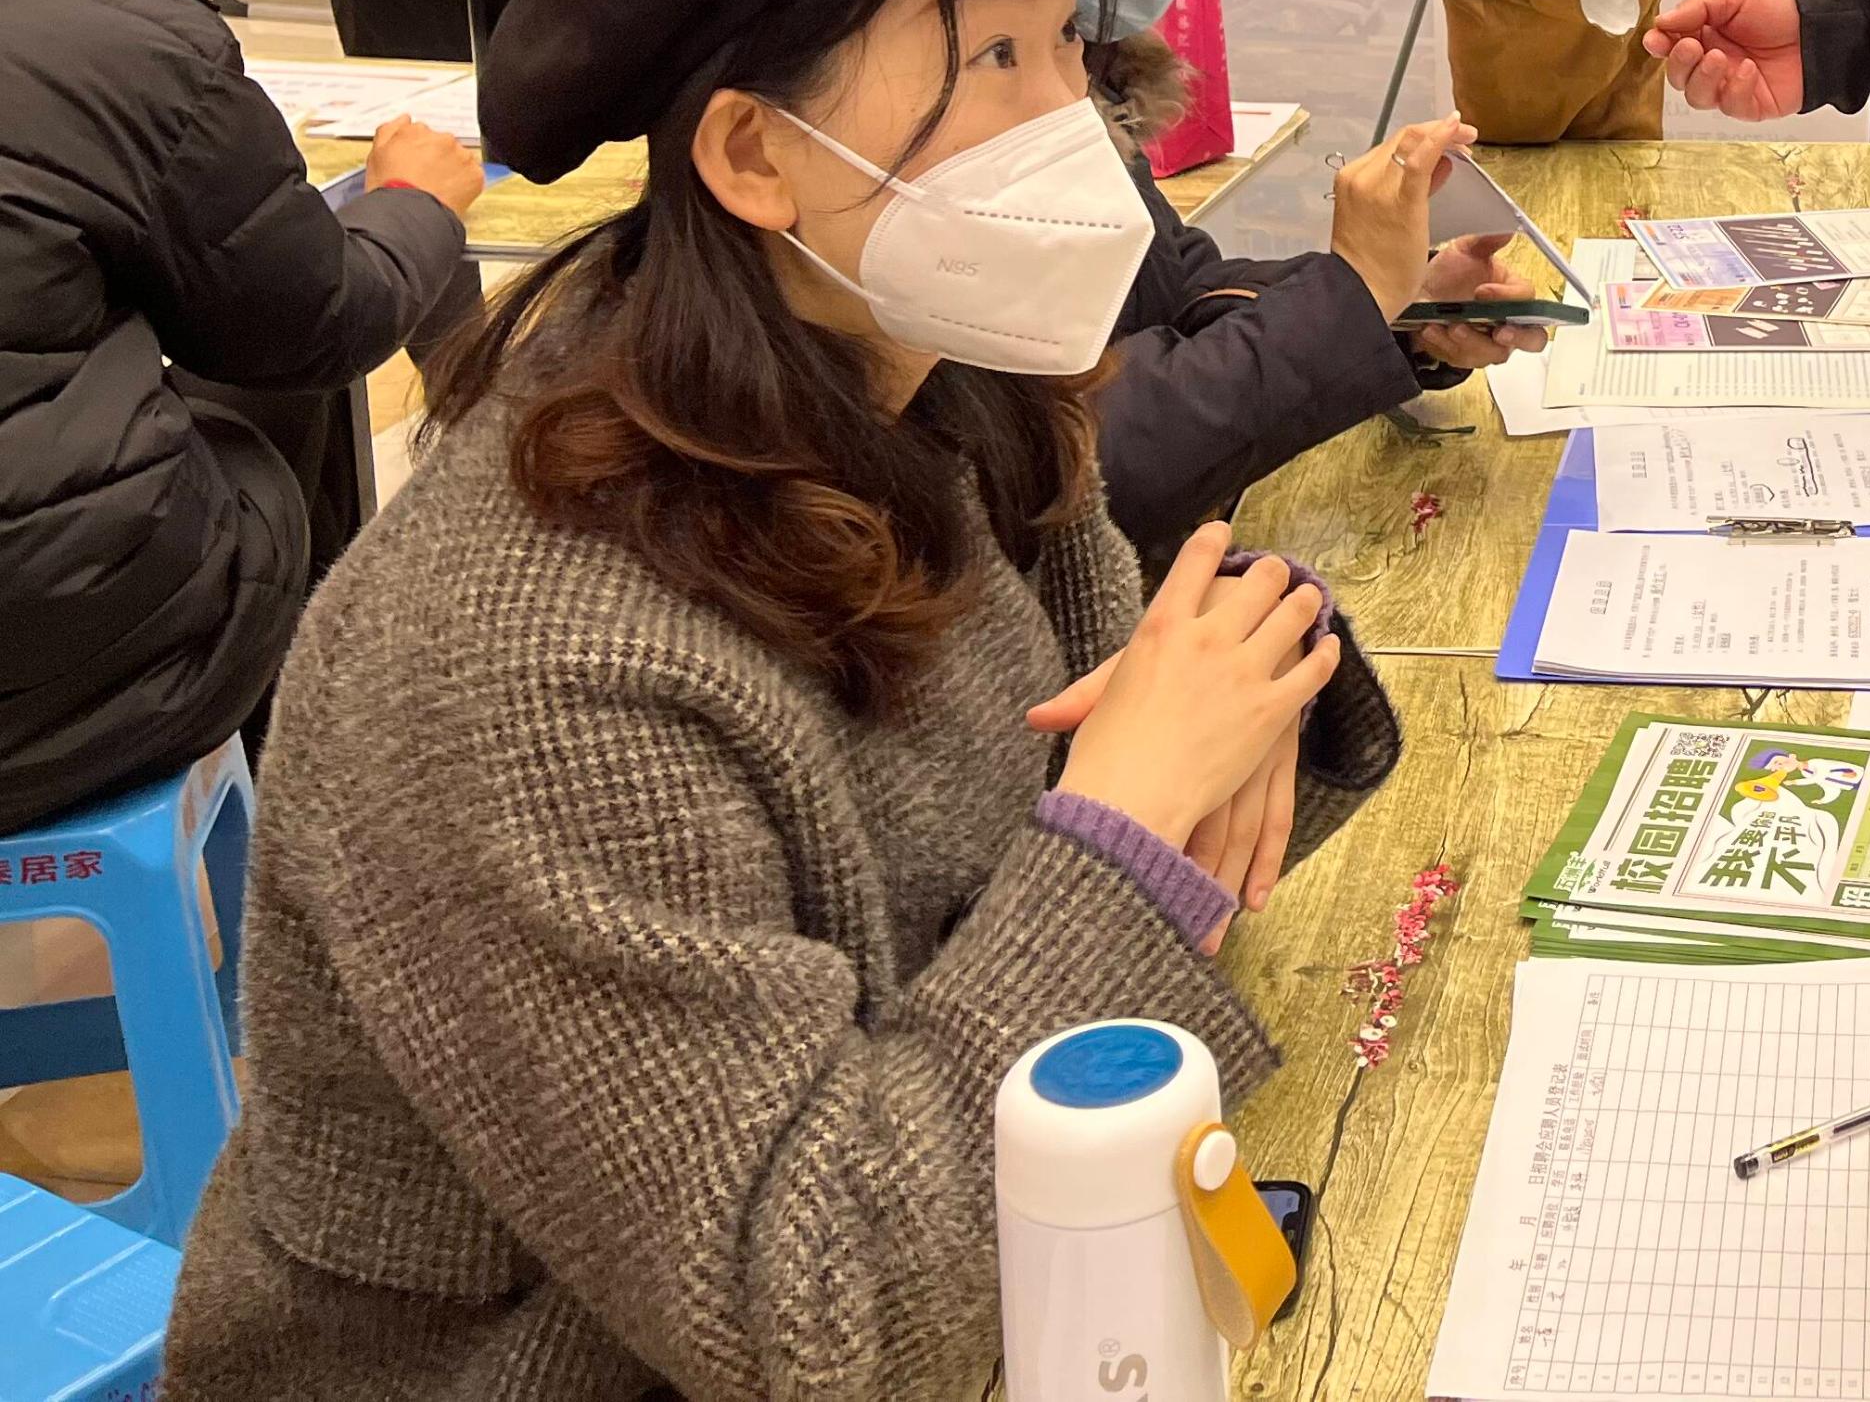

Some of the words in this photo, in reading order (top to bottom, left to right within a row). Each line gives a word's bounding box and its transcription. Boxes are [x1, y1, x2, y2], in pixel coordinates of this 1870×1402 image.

[936, 257, 980, 277] N95
[1609, 758, 1719, 894] 校园招聘
[1759, 815, 1816, 895] 不平凡
[1099, 1353, 1149, 1402] S
